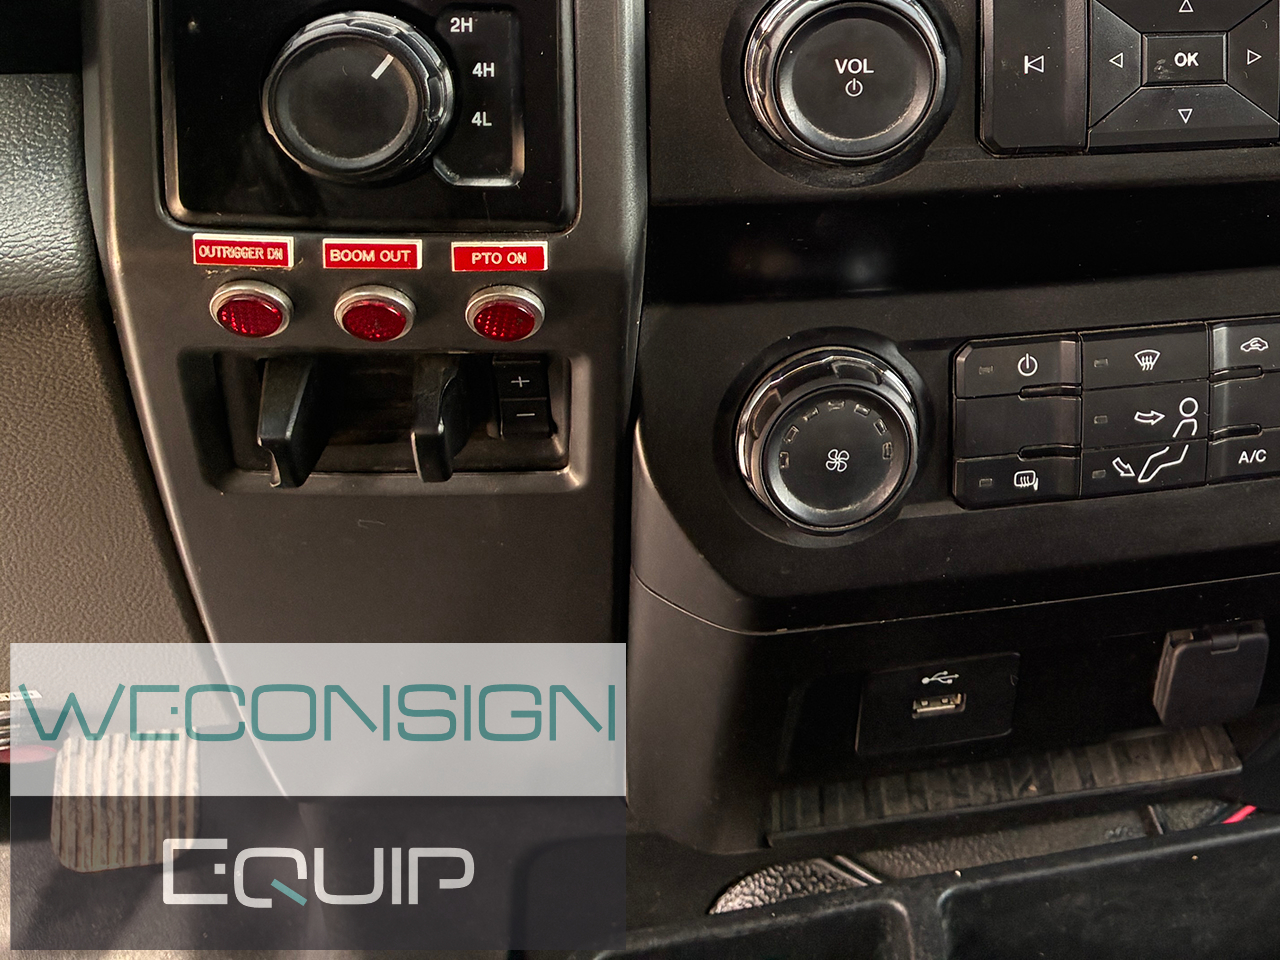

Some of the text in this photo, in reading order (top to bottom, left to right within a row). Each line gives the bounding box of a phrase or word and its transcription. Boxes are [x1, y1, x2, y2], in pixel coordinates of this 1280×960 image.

[450, 17, 473, 33] 2H
[834, 58, 875, 75] VOL
[1174, 52, 1199, 68] OK
[472, 62, 495, 78] 4H
[471, 111, 493, 127] 4L
[198, 244, 284, 261] OUTRIGGER DN
[329, 248, 412, 263] BOOM OUT
[470, 251, 528, 265] PTO ON
[1238, 448, 1267, 465] A/C
